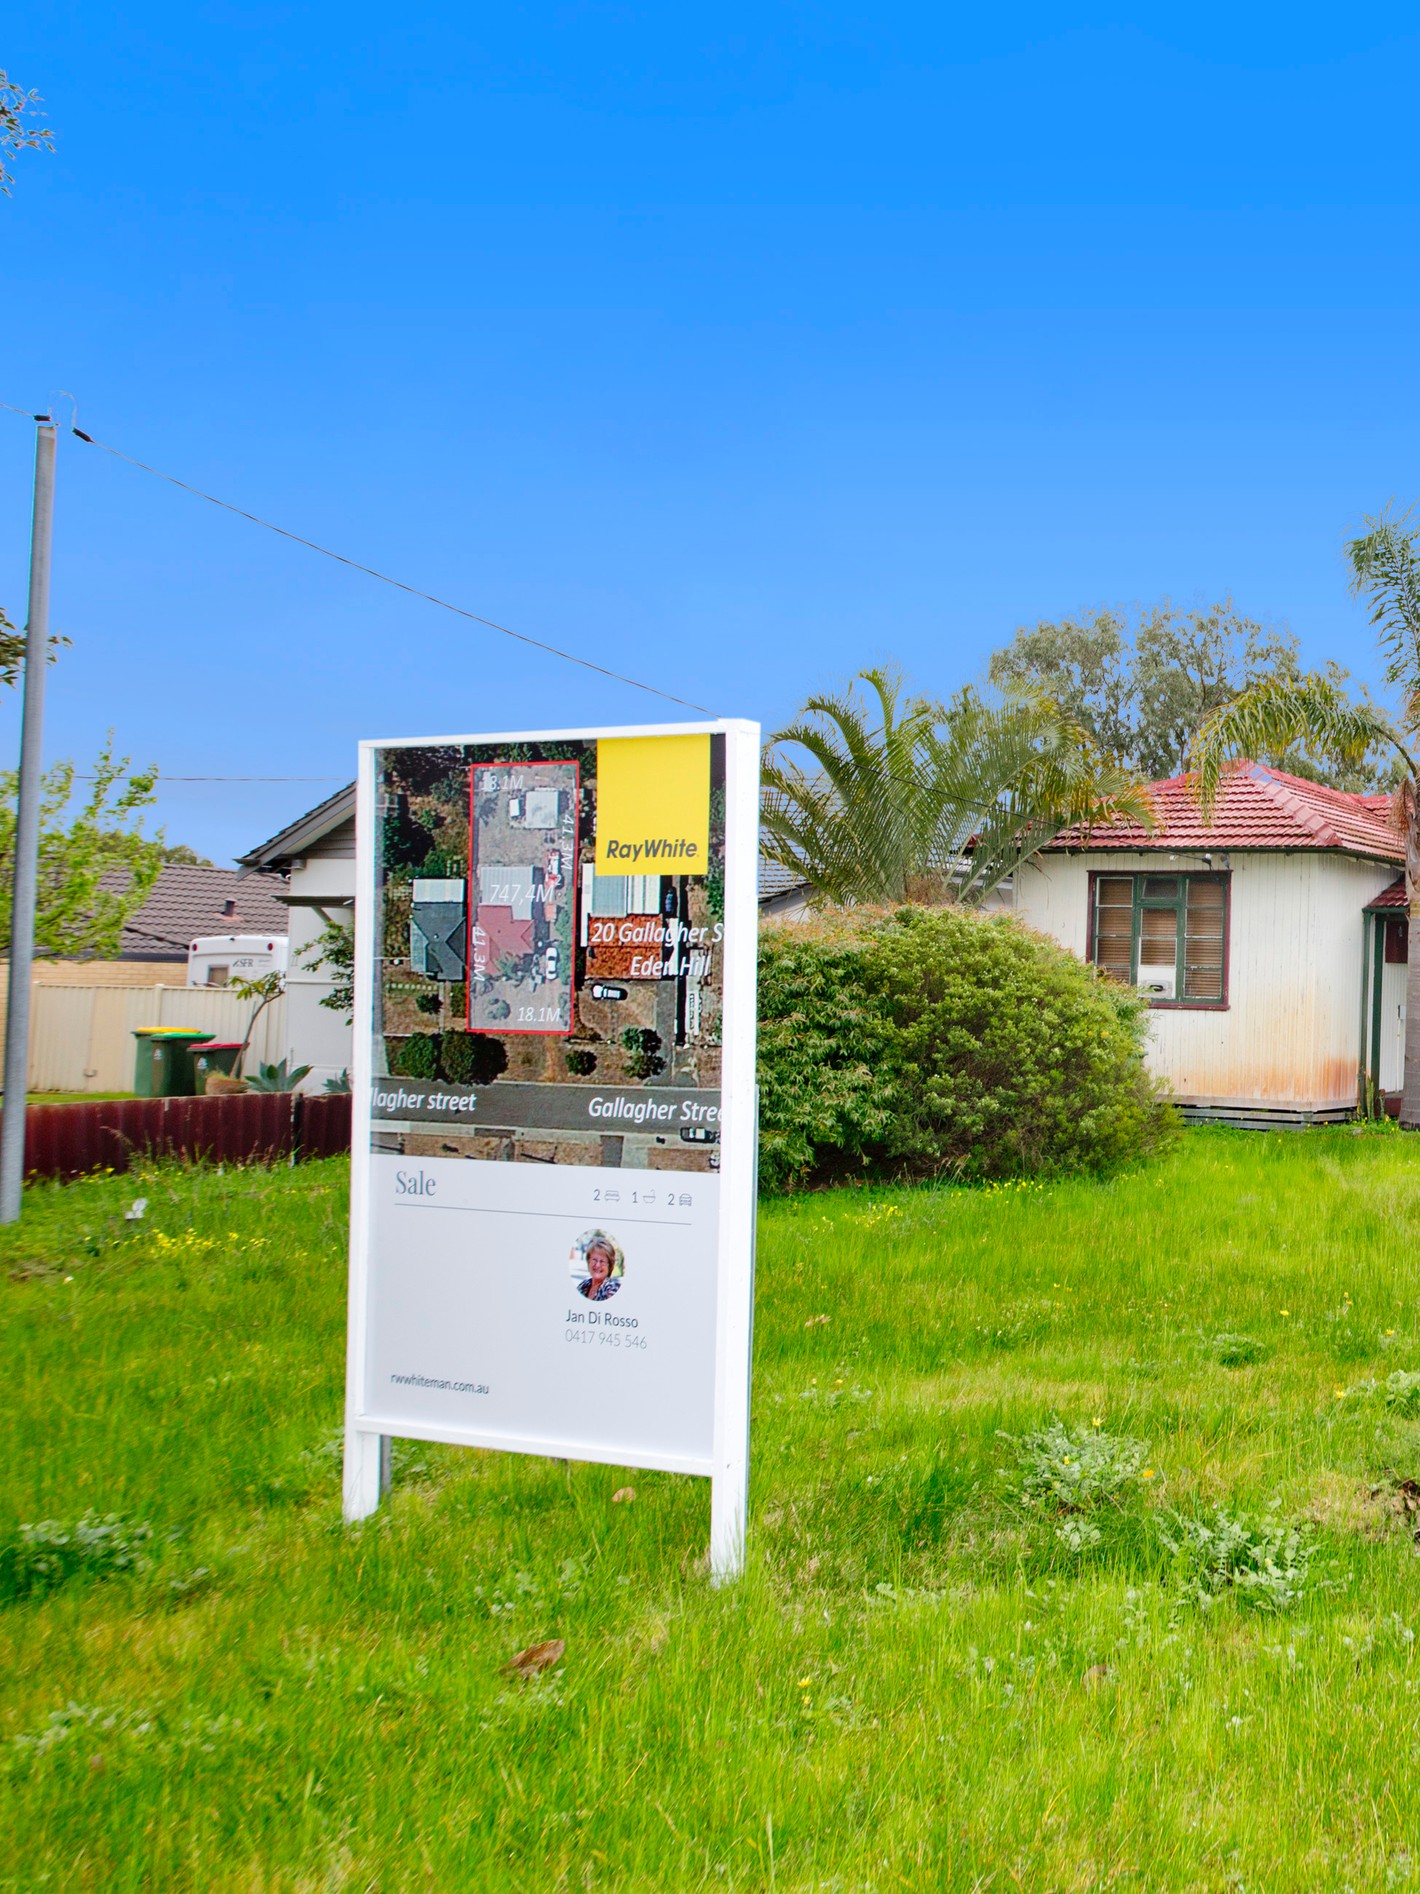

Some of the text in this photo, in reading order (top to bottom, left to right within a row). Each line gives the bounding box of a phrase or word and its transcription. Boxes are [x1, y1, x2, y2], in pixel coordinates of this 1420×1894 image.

[480, 774, 524, 790] 18.1M
[561, 814, 574, 870] 41.3M
[606, 838, 698, 862] RayWhite
[591, 922, 615, 943] 20
[618, 921, 709, 947] Gallagher
[472, 926, 486, 982] 41.3M
[630, 954, 711, 976] Eden Hill
[517, 1006, 561, 1022] 18.1M
[426, 1092, 478, 1112] street
[588, 1096, 678, 1124] Gallagher
[395, 1170, 436, 1196] Sale
[593, 1188, 675, 1206] 2 1 2
[565, 1309, 639, 1328] Jan Di Rosso
[564, 1328, 648, 1350] 0417 945 546
[390, 1374, 489, 1395] rwwhiteman.com.au
